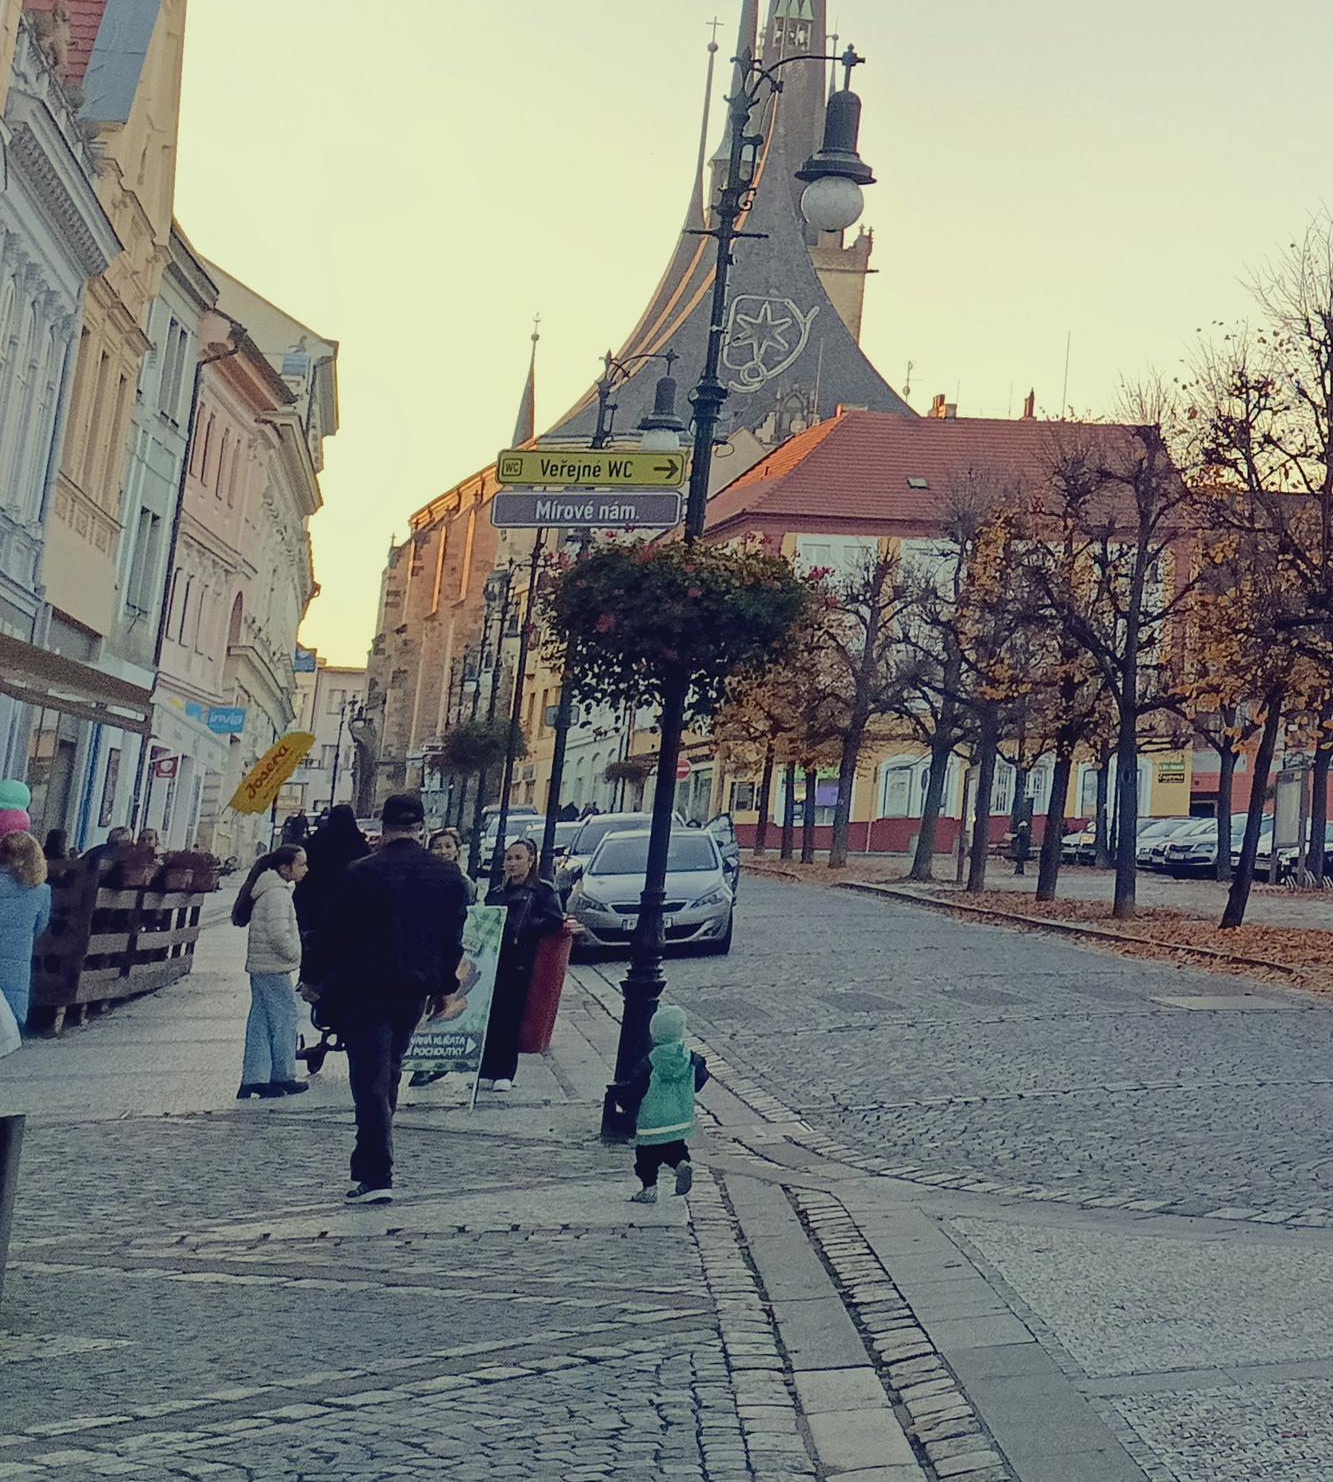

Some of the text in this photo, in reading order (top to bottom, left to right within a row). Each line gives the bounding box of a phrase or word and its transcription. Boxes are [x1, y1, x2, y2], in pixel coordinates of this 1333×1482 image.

[539, 459, 634, 483] Veřejné WC
[535, 499, 640, 520] Mírové nám.
